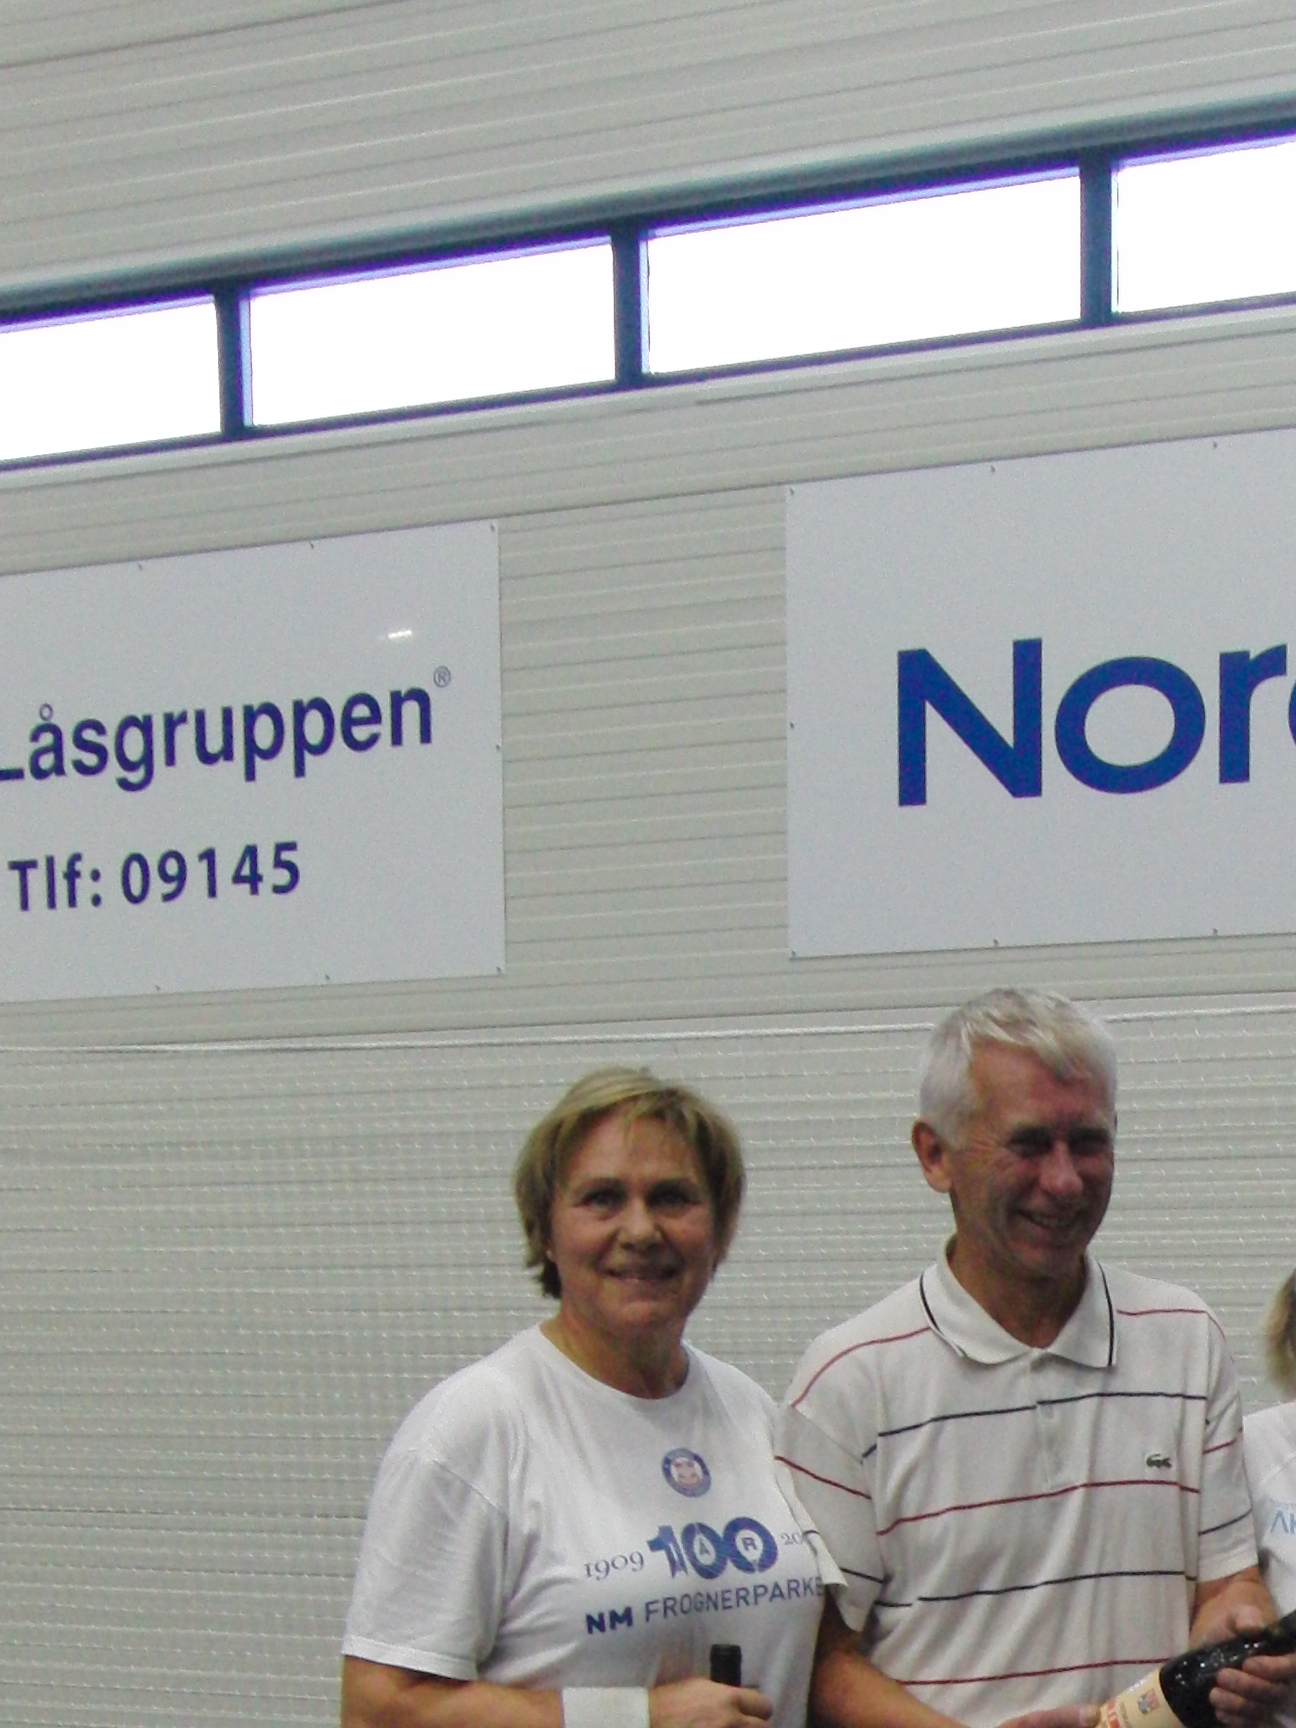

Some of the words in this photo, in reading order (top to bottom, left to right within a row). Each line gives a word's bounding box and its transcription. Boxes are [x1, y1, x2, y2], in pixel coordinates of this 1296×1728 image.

[7, 851, 103, 912] Tlf:
[120, 840, 301, 906] 09145
[585, 1551, 645, 1581] 1909
[646, 1516, 779, 1580] 100
[585, 1606, 634, 1635] NM
